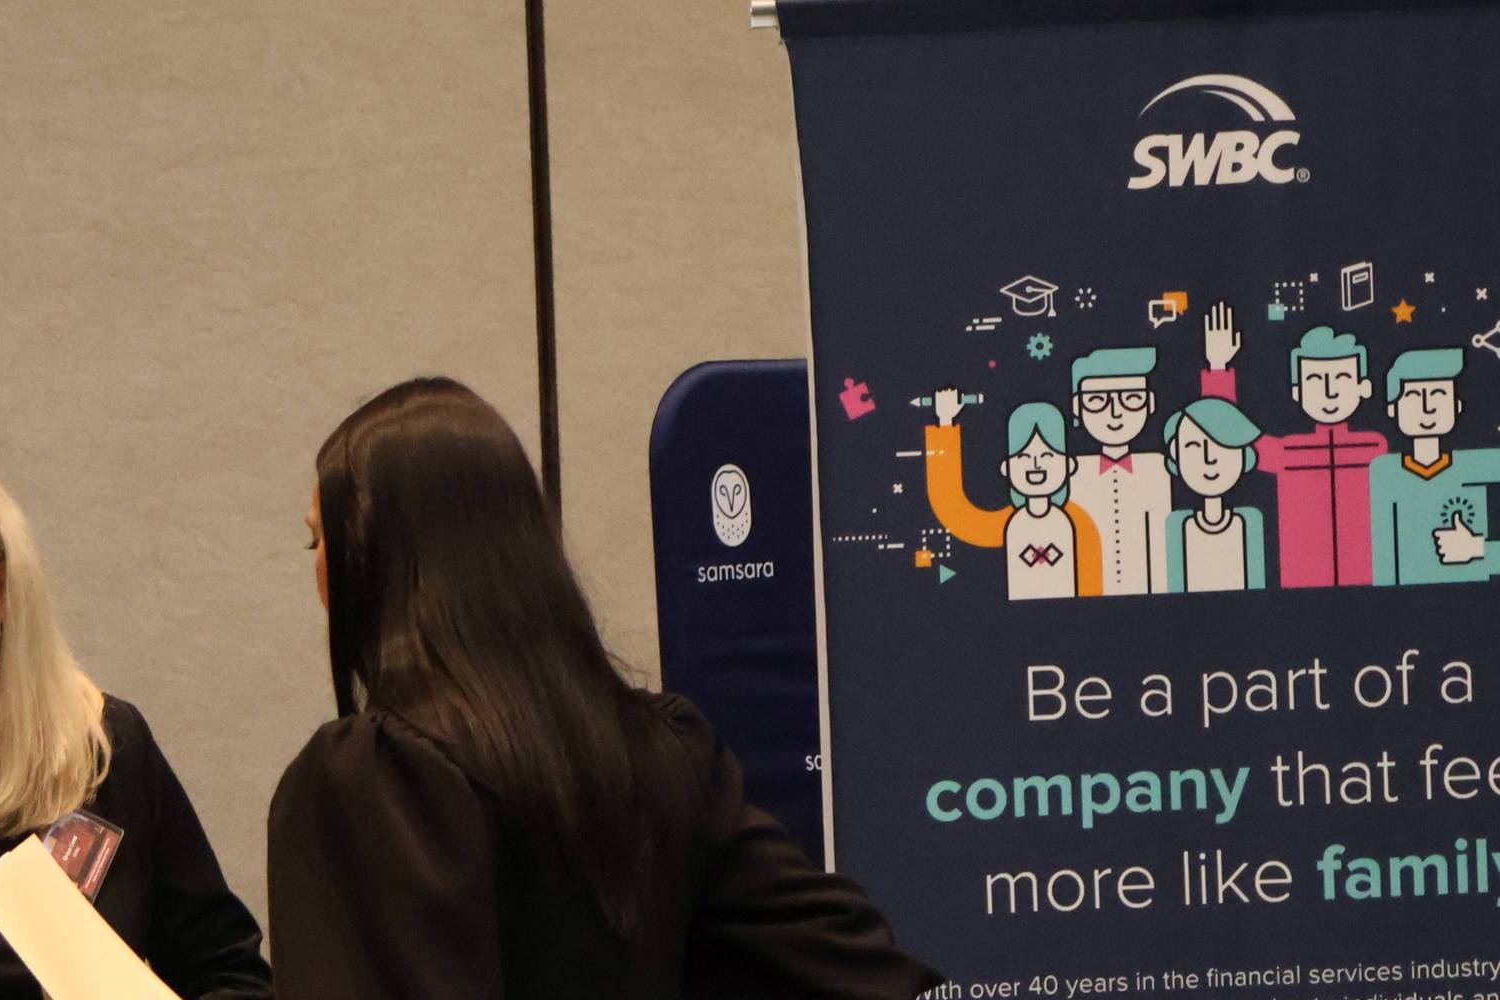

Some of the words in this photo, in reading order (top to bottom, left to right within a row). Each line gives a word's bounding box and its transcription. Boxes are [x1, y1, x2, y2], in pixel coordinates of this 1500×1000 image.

[697, 560, 774, 583] samsara
[1027, 665, 1112, 722] Be
[1139, 671, 1173, 717] a
[1202, 658, 1330, 728] part
[1353, 649, 1419, 710] of
[1440, 660, 1473, 705] a
[926, 765, 1250, 829] company
[1270, 750, 1397, 808] that
[985, 866, 1155, 914] more
[1183, 850, 1293, 906] like
[970, 980, 1020, 999] over
[1029, 975, 1058, 996] 40
[1066, 974, 1128, 999] years
[1136, 972, 1154, 991] in
[1162, 971, 1199, 990] the
[1206, 964, 1300, 988] financial
[1309, 963, 1402, 984] services
[1411, 958, 1500, 982] industry
